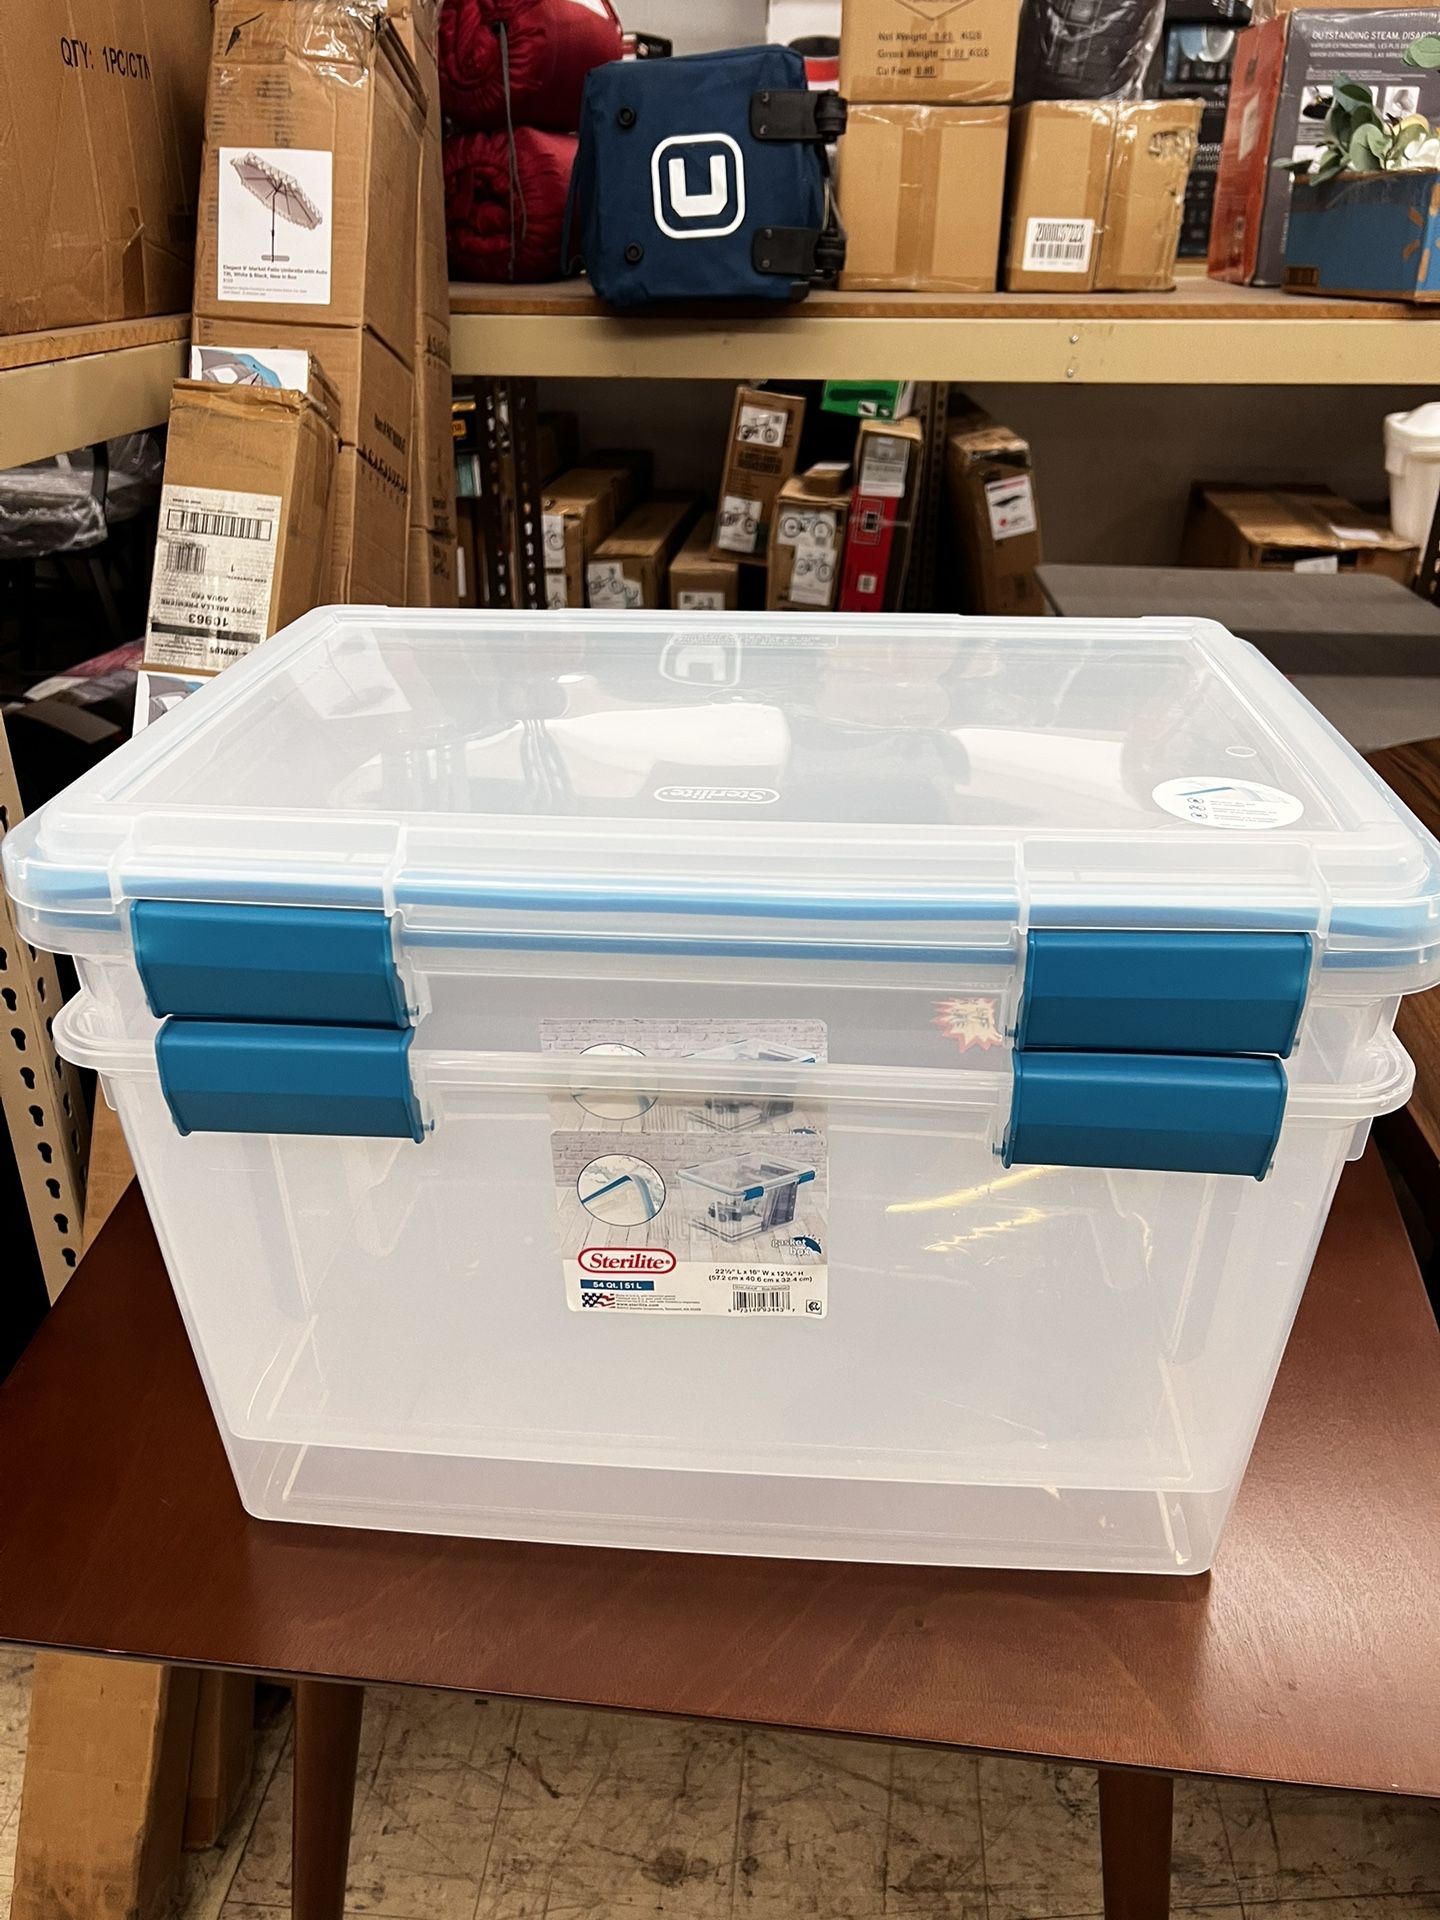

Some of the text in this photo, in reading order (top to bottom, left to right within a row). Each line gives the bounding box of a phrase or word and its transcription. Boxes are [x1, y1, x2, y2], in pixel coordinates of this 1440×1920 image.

[896, 32, 927, 44] Weight
[1312, 31, 1370, 40] OUTSTANDING
[60, 36, 94, 70] QTY:
[878, 49, 904, 58] Gross
[907, 49, 938, 60] Weight
[668, 154, 728, 218] U
[161, 598, 198, 609] PREMIERE
[207, 594, 229, 602] AQUA
[188, 614, 229, 627] 10963
[670, 789, 766, 801] Sterilite
[771, 1239, 806, 1248] gasket
[789, 1247, 810, 1256] box
[589, 1253, 665, 1270] Sterilite
